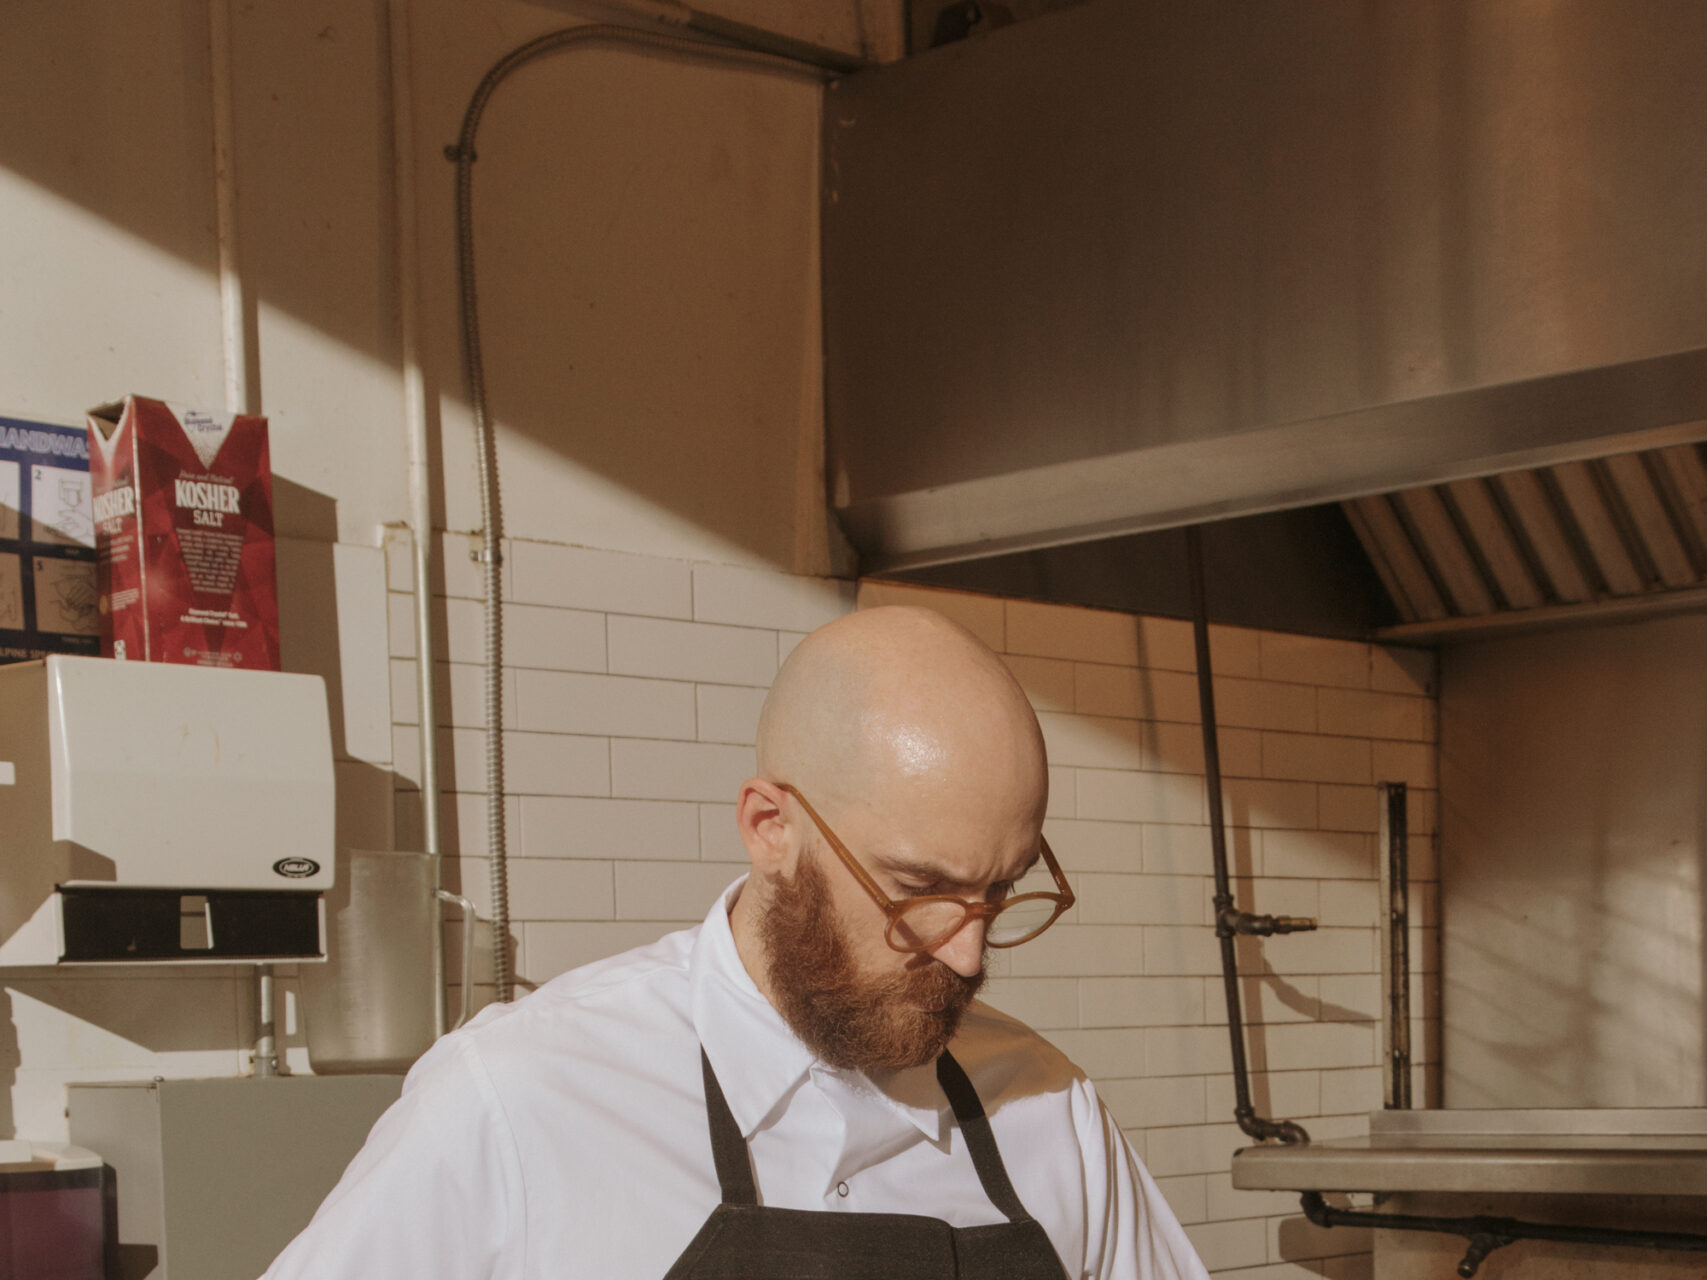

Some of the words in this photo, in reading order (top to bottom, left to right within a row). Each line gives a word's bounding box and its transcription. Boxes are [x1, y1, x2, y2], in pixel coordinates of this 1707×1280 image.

[0, 426, 90, 460] ANDWA
[35, 469, 42, 480] 2
[175, 479, 240, 514] KOSHER
[193, 509, 224, 528] SALT
